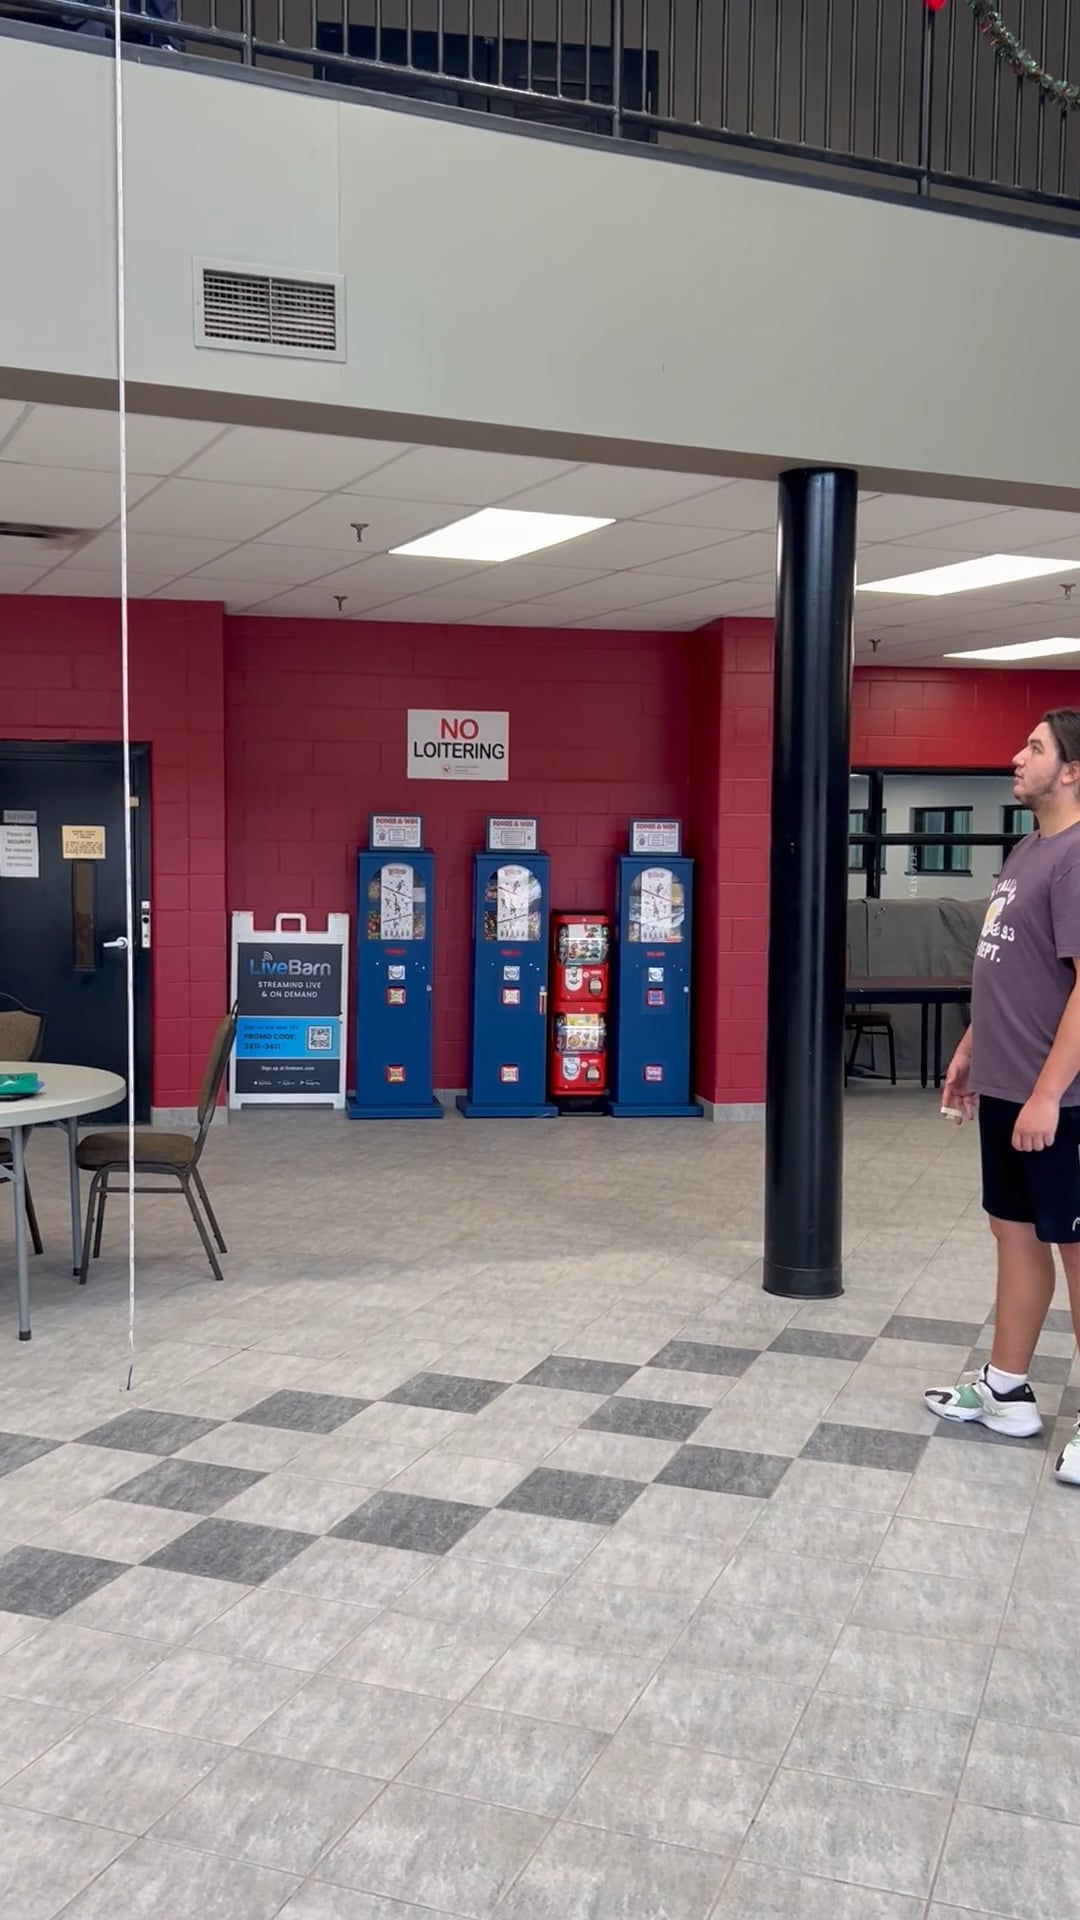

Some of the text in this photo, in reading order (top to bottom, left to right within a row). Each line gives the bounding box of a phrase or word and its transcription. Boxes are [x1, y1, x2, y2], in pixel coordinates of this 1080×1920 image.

[441, 718, 479, 740] NO
[413, 741, 505, 760] LOITERING
[249, 958, 331, 976] LiveBarn
[257, 981, 304, 989] STREAMING
[261, 990, 268, 998] &
[269, 990, 282, 998] ON
